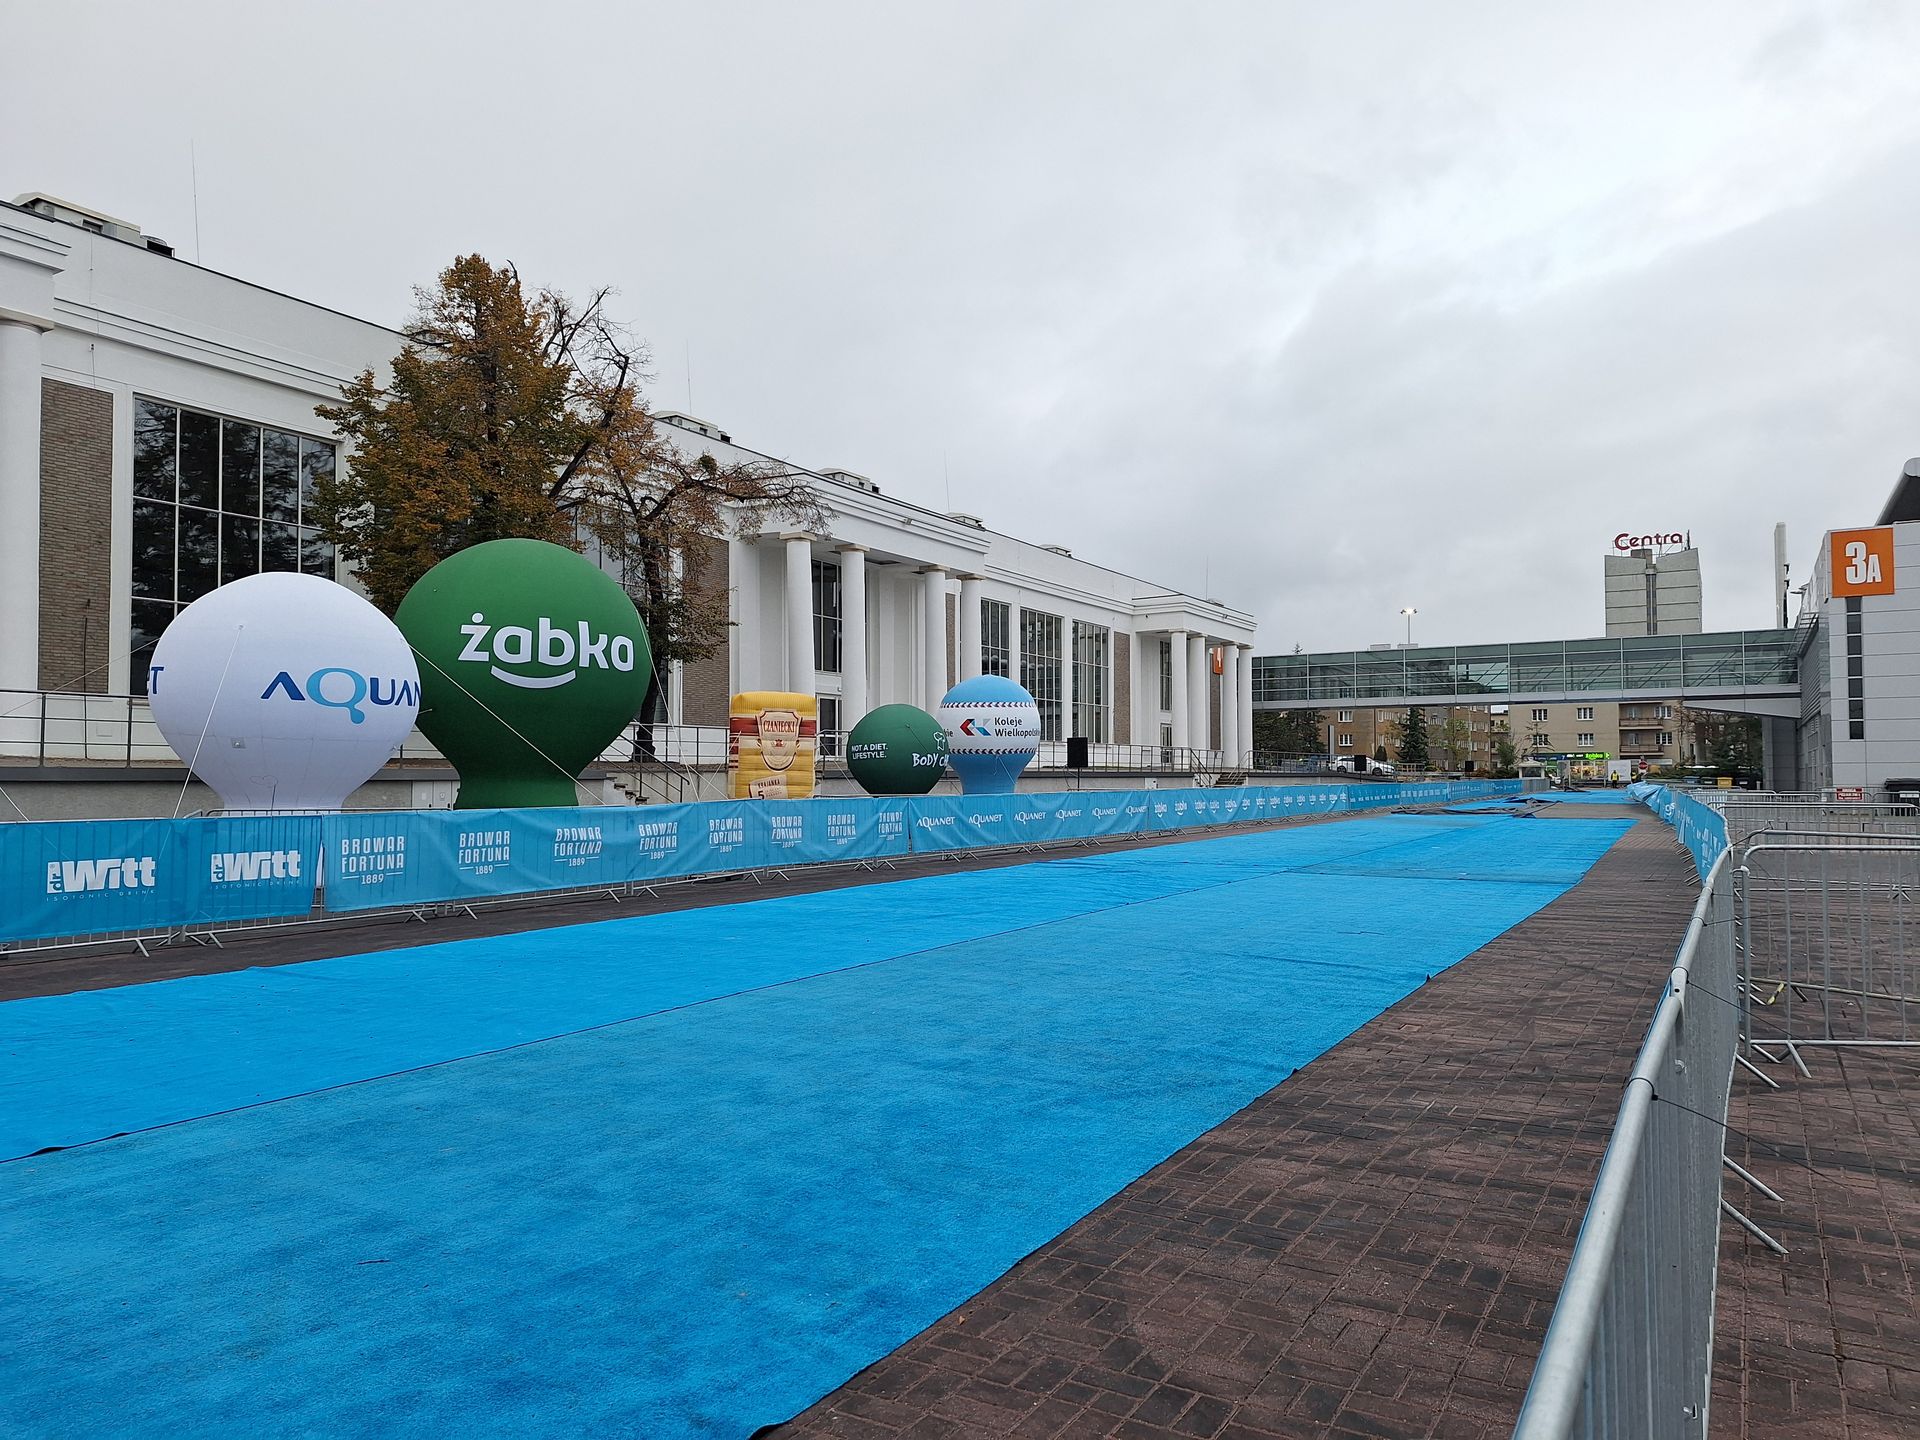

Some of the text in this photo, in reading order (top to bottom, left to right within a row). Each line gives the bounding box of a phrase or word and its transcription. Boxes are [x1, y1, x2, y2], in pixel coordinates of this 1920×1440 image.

[1614, 532, 1683, 550] Centra
[1844, 541, 1882, 585] 3A
[457, 612, 635, 672] żabka
[763, 720, 795, 733] CZANIECKI
[994, 716, 1023, 728] Koleje
[851, 744, 862, 752] NOT
[869, 742, 889, 751] DIET.
[852, 750, 887, 760] LIFESTYLE.
[709, 817, 743, 831] BROWAR
[771, 815, 803, 828] BROWAR
[827, 814, 856, 826] BROWAR
[555, 826, 601, 842] BROWAR
[638, 821, 679, 837] BROWAR
[771, 827, 802, 840] FORTUNA
[827, 825, 857, 837] FORTUNA
[459, 830, 511, 848] BROWAR
[639, 835, 678, 850] FORTUNA
[708, 830, 743, 844] FORTUNA
[341, 835, 405, 856] BROWAR
[554, 841, 602, 857] FORTUNA
[458, 846, 510, 864] FORTUNA
[223, 849, 301, 882] Witt
[341, 853, 404, 873] FORTUNA
[475, 864, 494, 875] 1889
[568, 857, 586, 868] 1889
[62, 856, 156, 893] Witt
[360, 873, 385, 885] 1889
